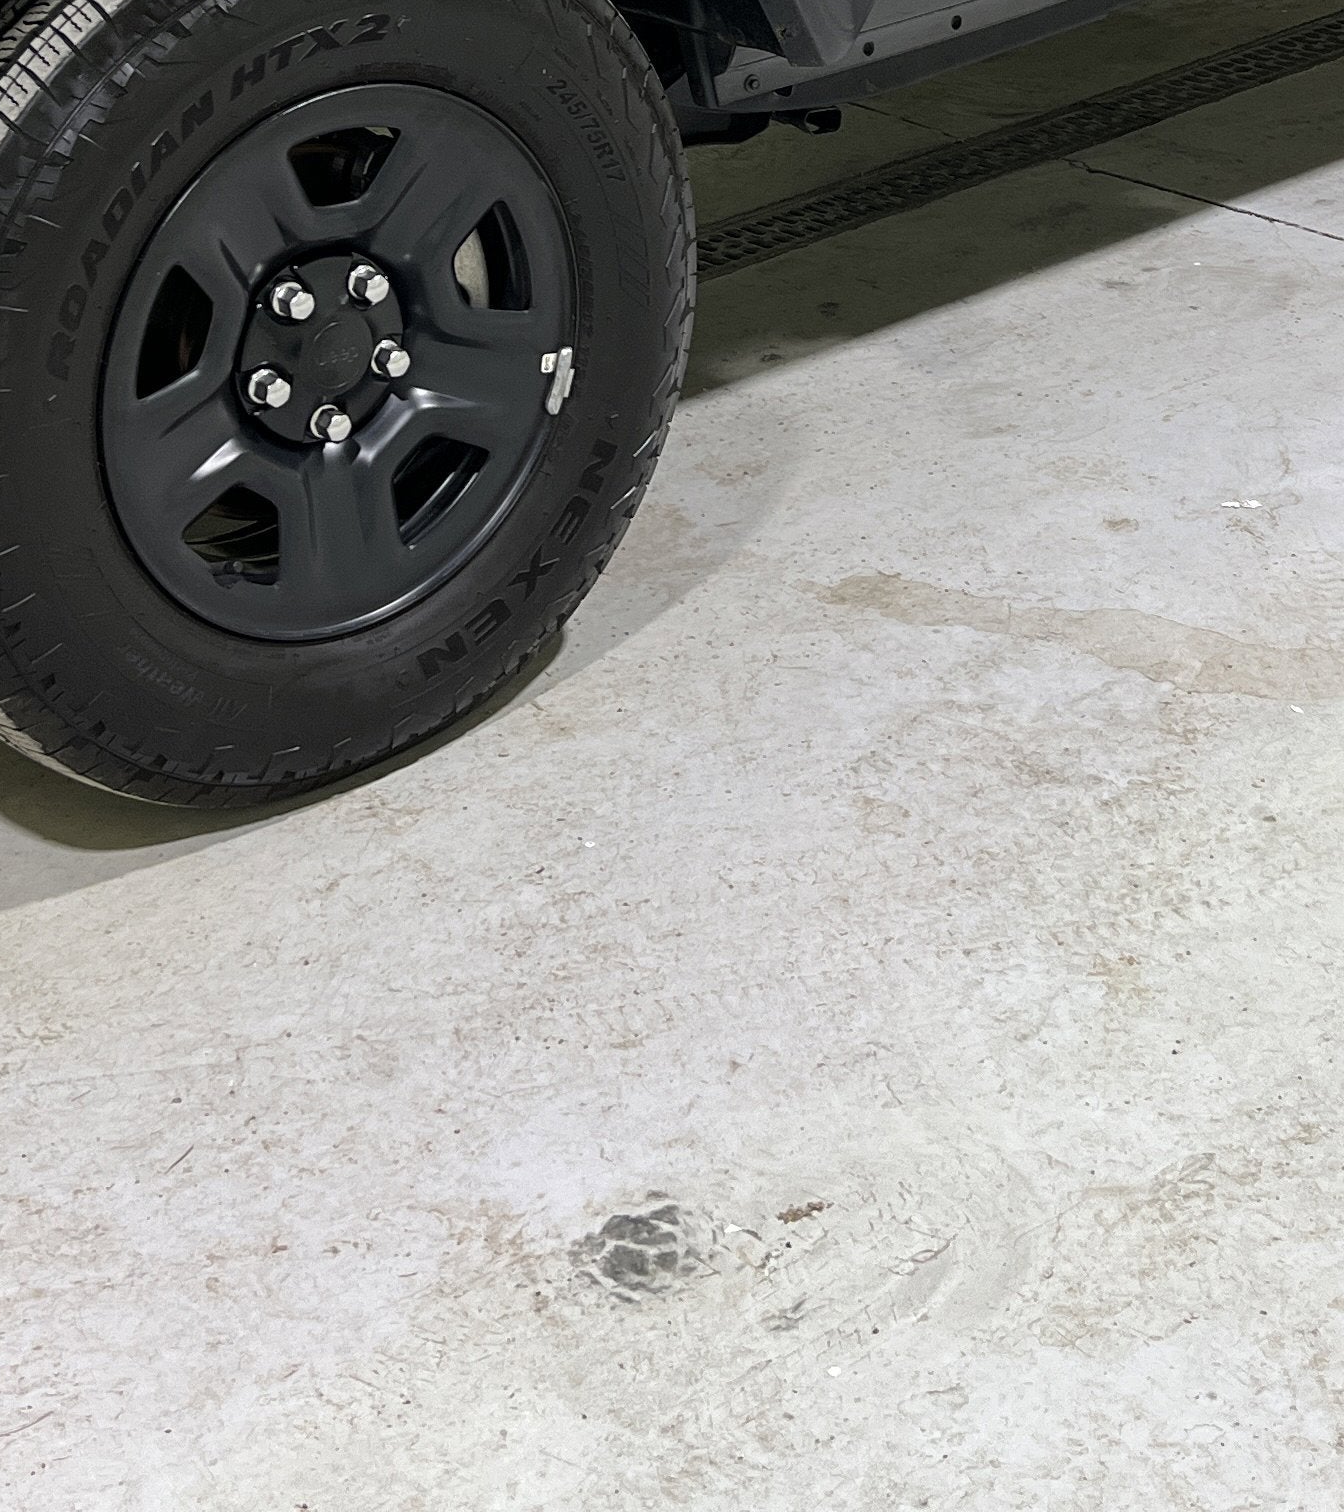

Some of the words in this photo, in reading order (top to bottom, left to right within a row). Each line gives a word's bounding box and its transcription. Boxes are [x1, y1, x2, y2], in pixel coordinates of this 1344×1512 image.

[47, 89, 215, 381] ROADIAN
[546, 78, 627, 184] 245/75R17
[415, 438, 618, 681] NEXEN
